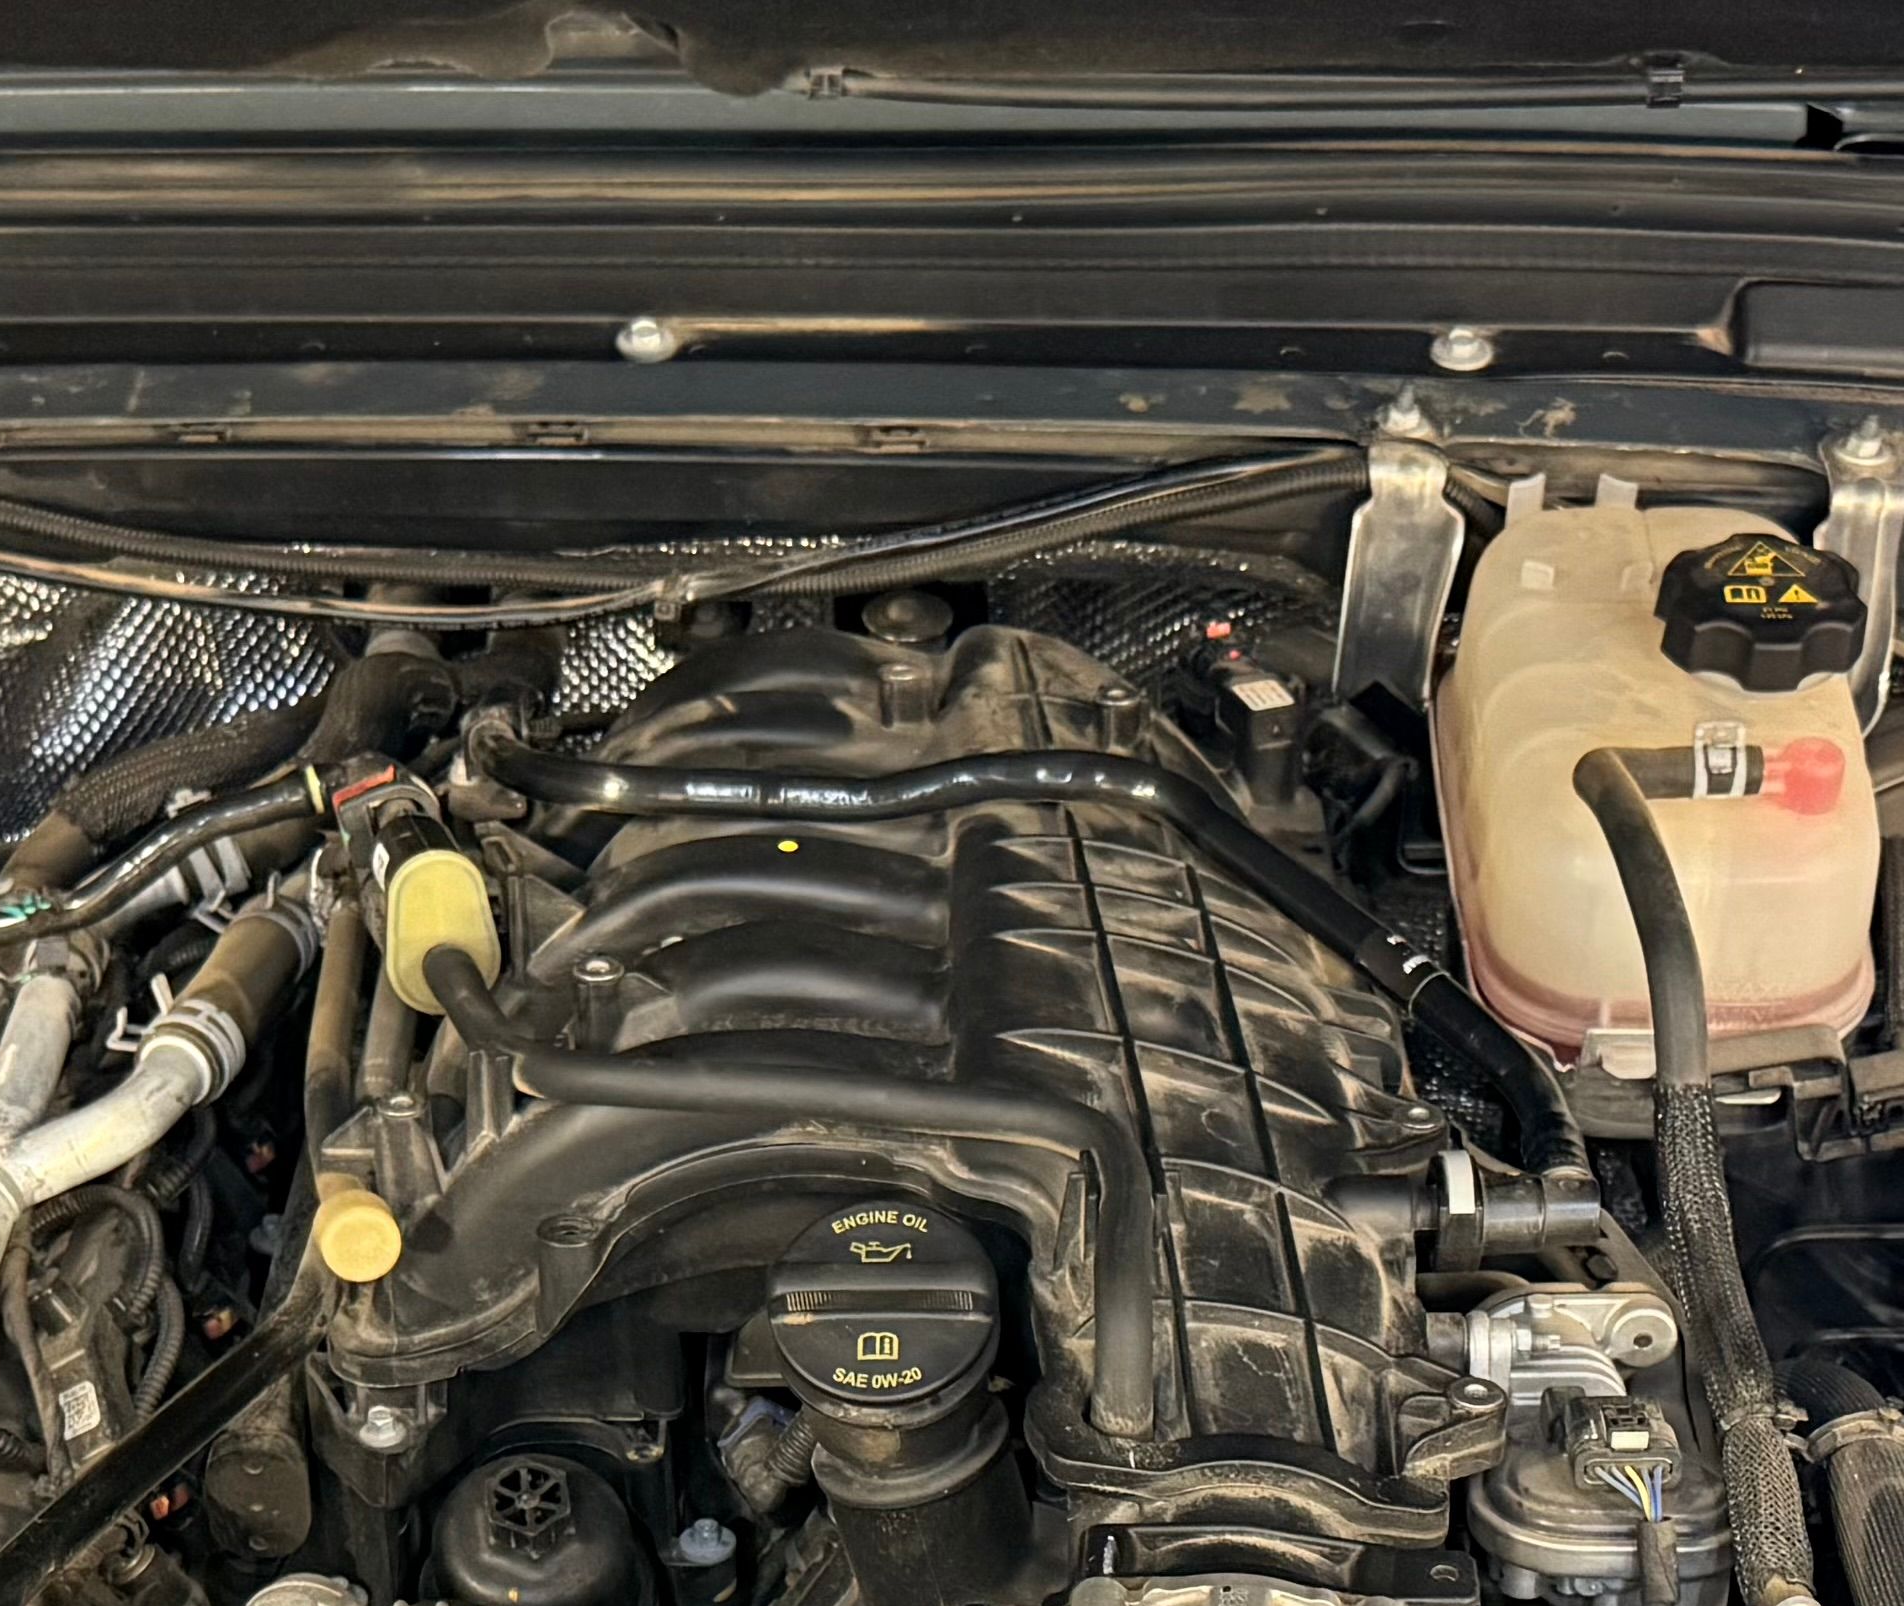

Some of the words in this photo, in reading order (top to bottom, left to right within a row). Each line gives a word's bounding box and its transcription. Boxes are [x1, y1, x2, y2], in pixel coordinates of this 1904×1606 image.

[831, 1210, 899, 1235] ENGINE
[903, 1212, 930, 1234] OIL
[832, 1367, 868, 1388] SAE
[872, 1367, 922, 1389] 0W-20
